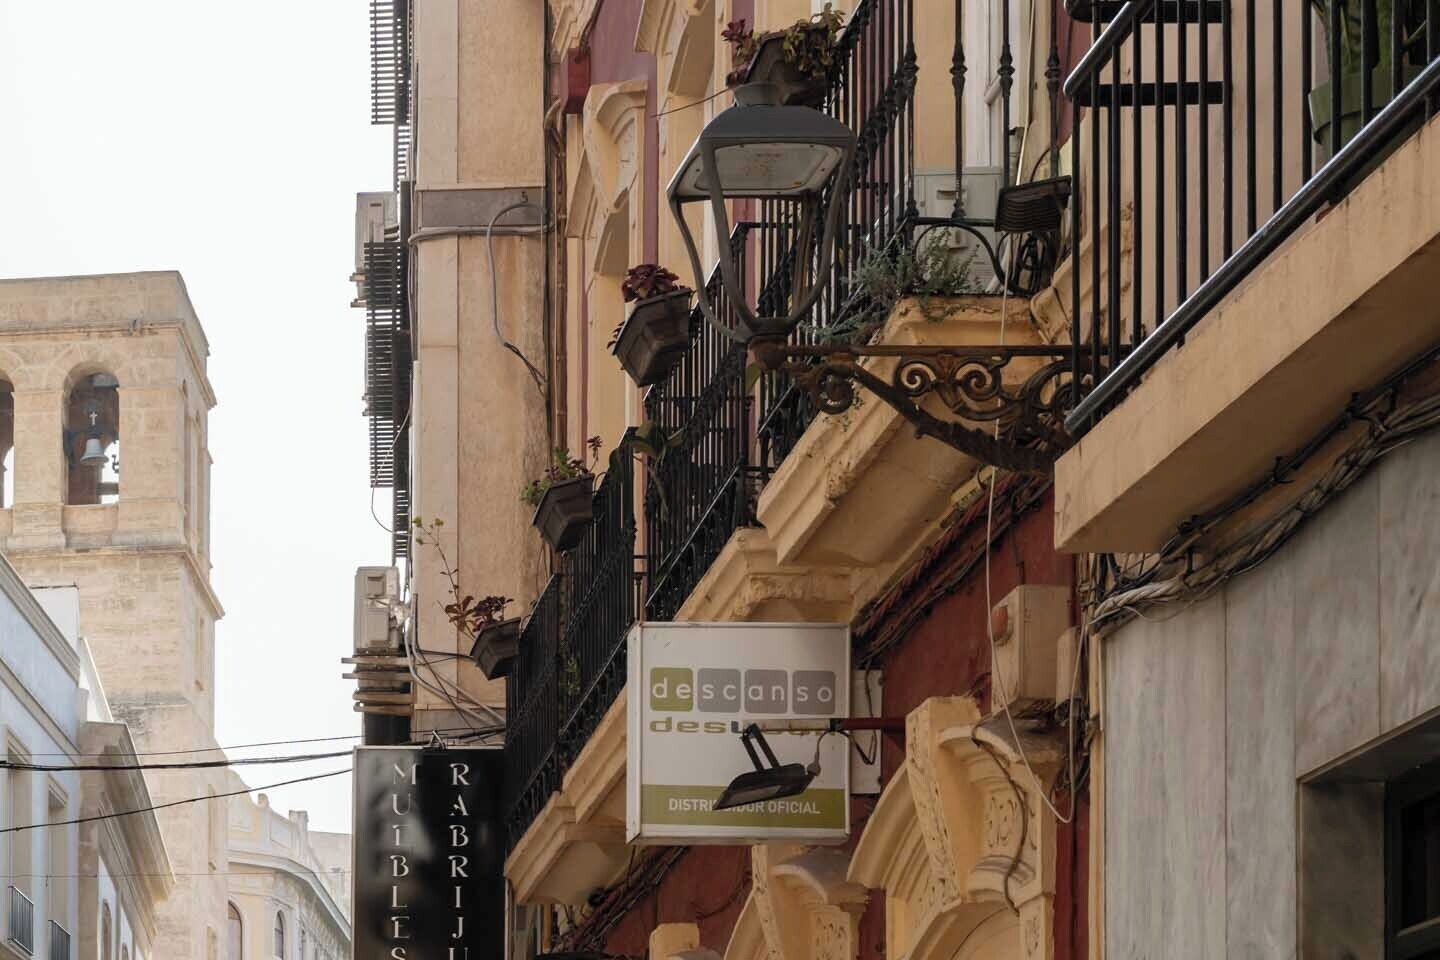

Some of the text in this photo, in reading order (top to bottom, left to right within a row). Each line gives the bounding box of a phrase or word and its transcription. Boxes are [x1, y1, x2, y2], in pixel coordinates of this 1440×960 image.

[652, 676, 833, 703] descanso
[668, 798, 821, 814] DISTRIDOR OFICIAL
